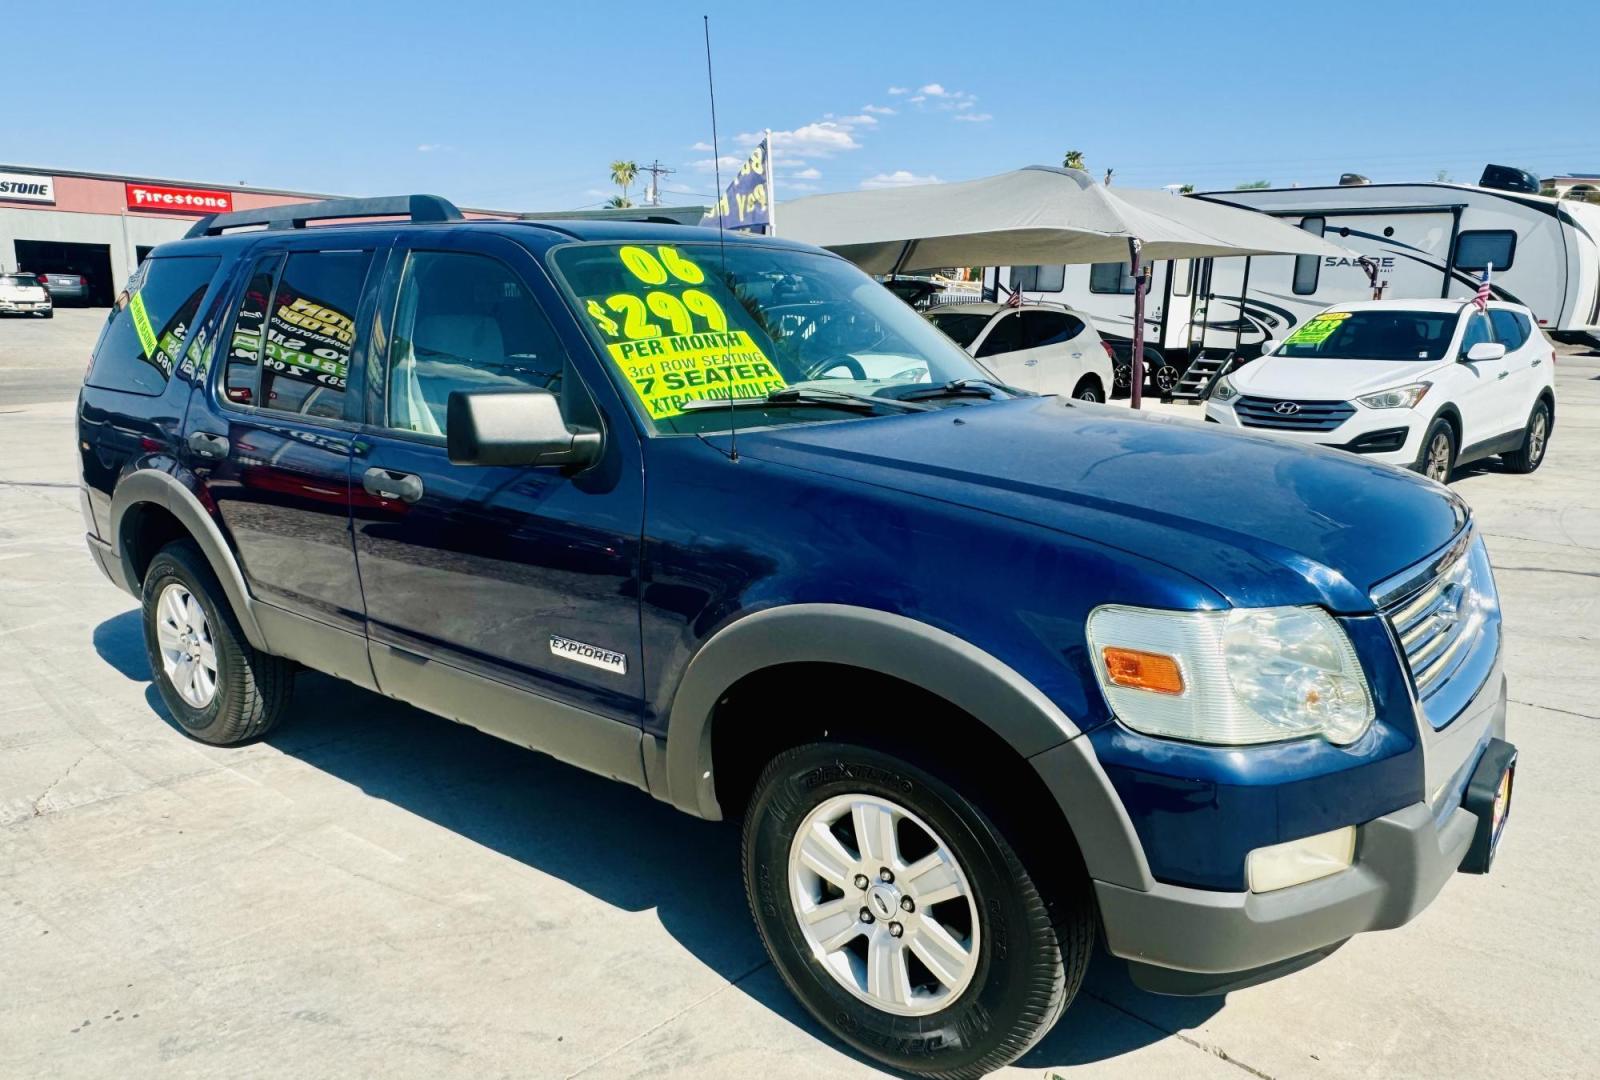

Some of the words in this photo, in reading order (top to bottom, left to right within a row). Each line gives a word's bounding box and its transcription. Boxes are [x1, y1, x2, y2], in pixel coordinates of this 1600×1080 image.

[133, 189, 227, 208] Firestone
[619, 246, 705, 285] 06
[587, 289, 728, 340] $299
[620, 340, 665, 360] PER
[670, 332, 743, 353] MONTH
[628, 363, 656, 379] 3rd
[660, 357, 697, 373] ROW
[702, 351, 763, 367] SEATING
[636, 378, 655, 395] 7
[663, 362, 774, 391] SEATER
[649, 393, 693, 414] XTRA
[735, 379, 786, 400] MILES
[551, 638, 622, 666] EXPLORER
